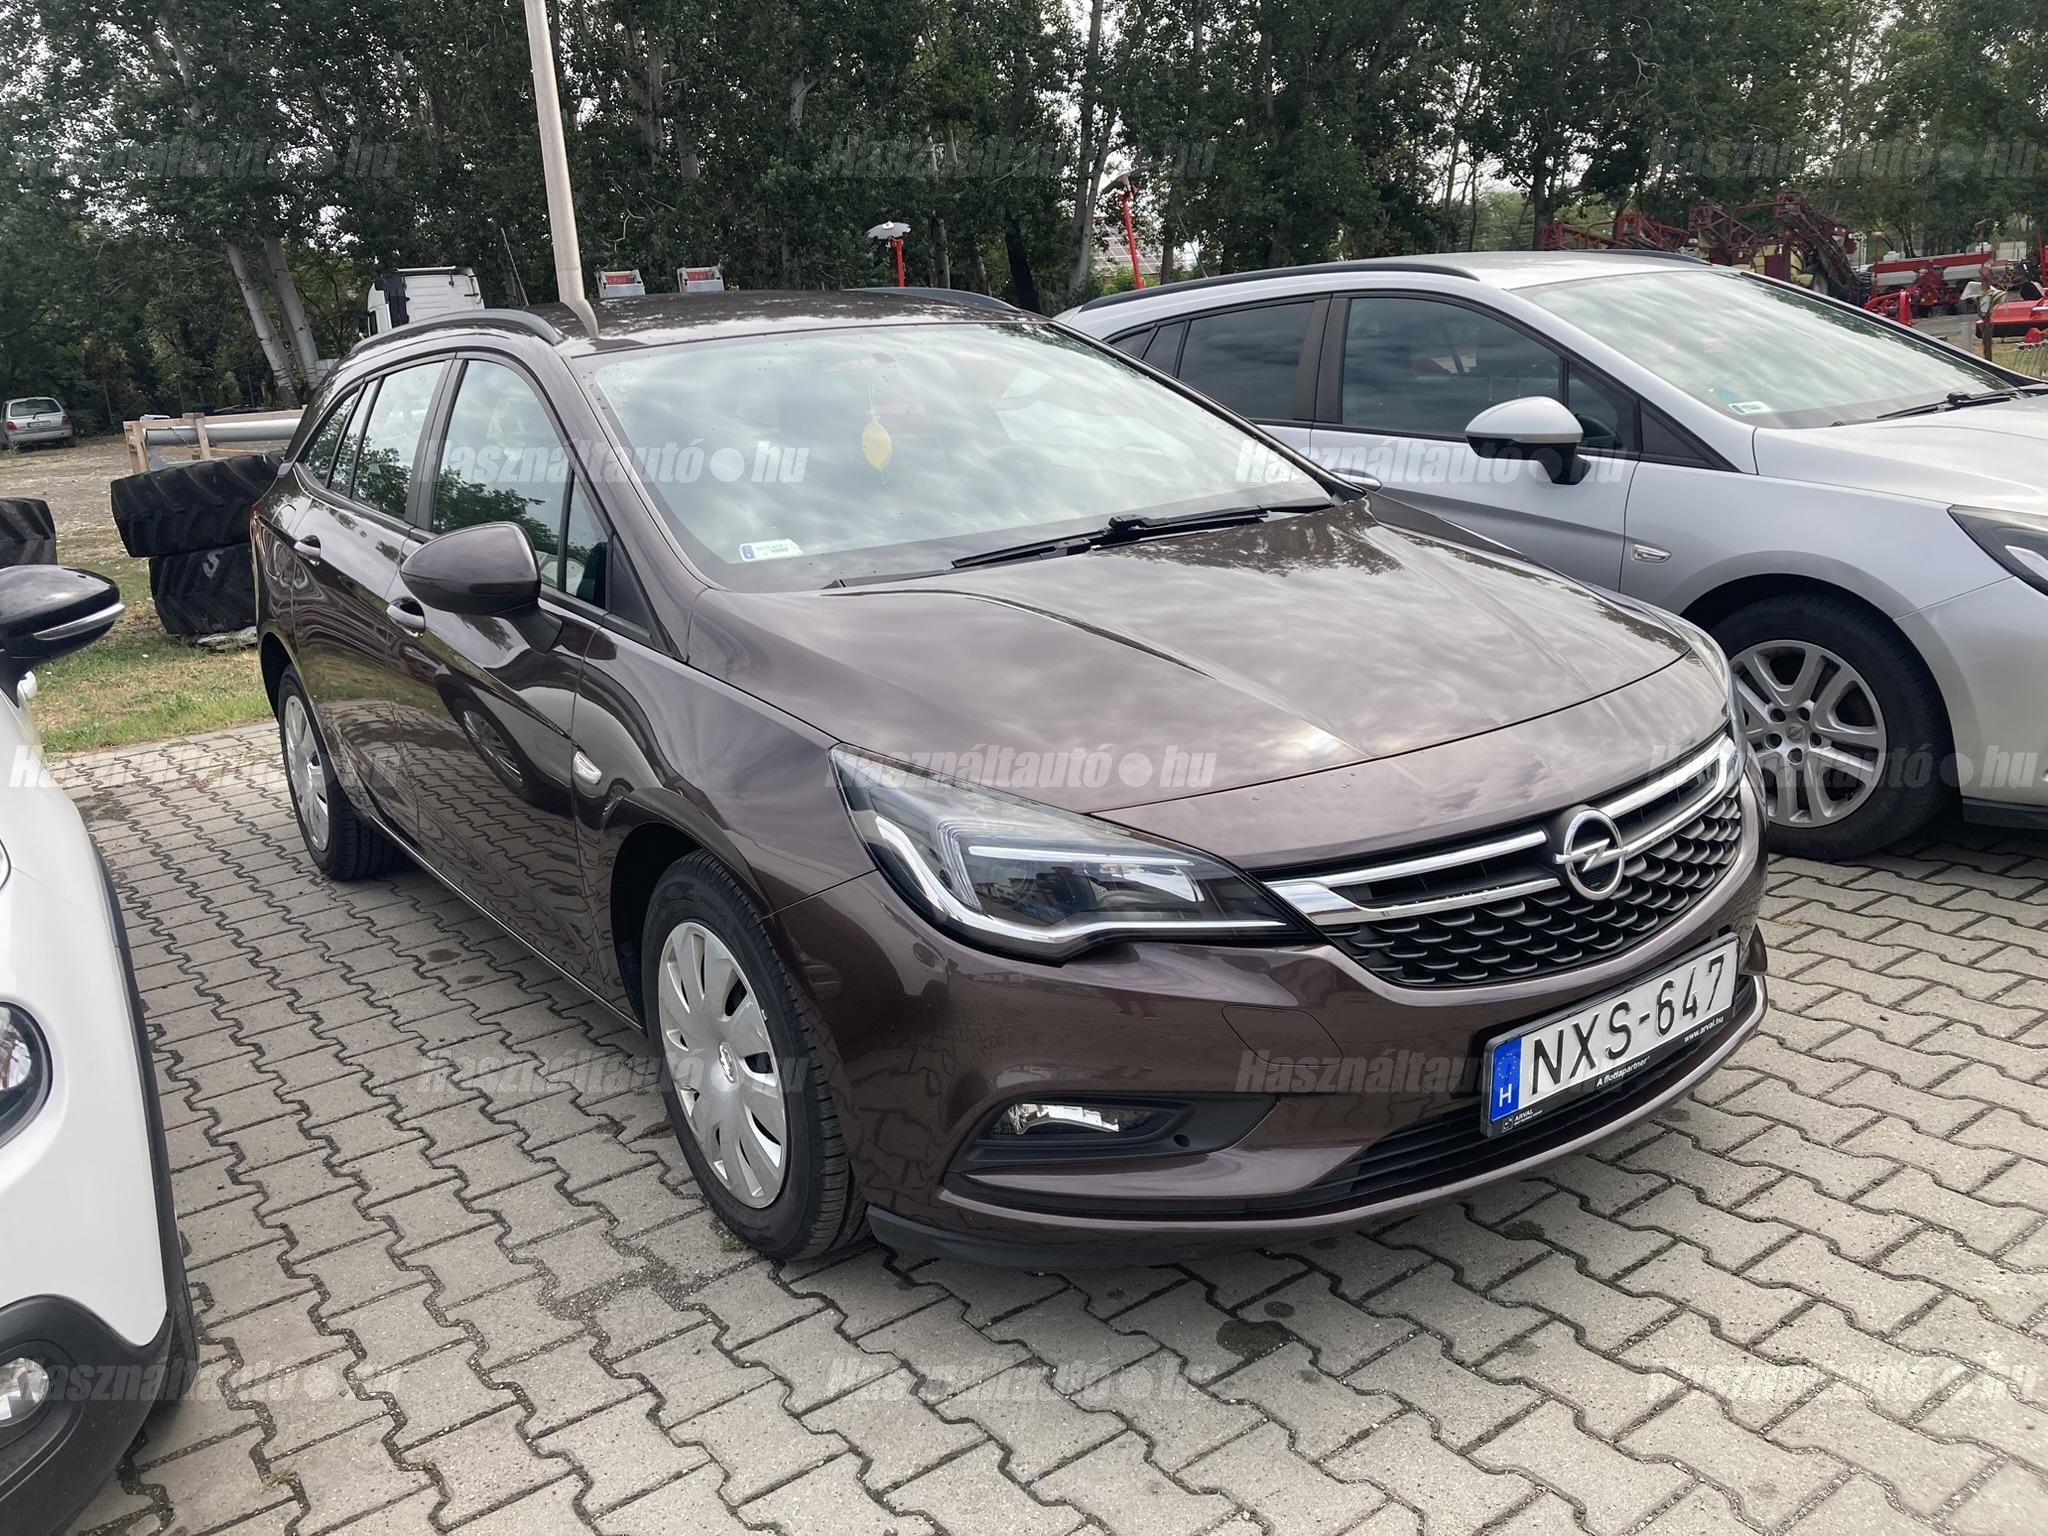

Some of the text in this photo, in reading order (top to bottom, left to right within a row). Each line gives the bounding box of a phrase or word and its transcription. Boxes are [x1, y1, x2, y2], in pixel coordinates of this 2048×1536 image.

[1531, 953, 1726, 1097] NXS-647
[1499, 1084, 1513, 1108] H
[1514, 1108, 1534, 1122] ARVAL
